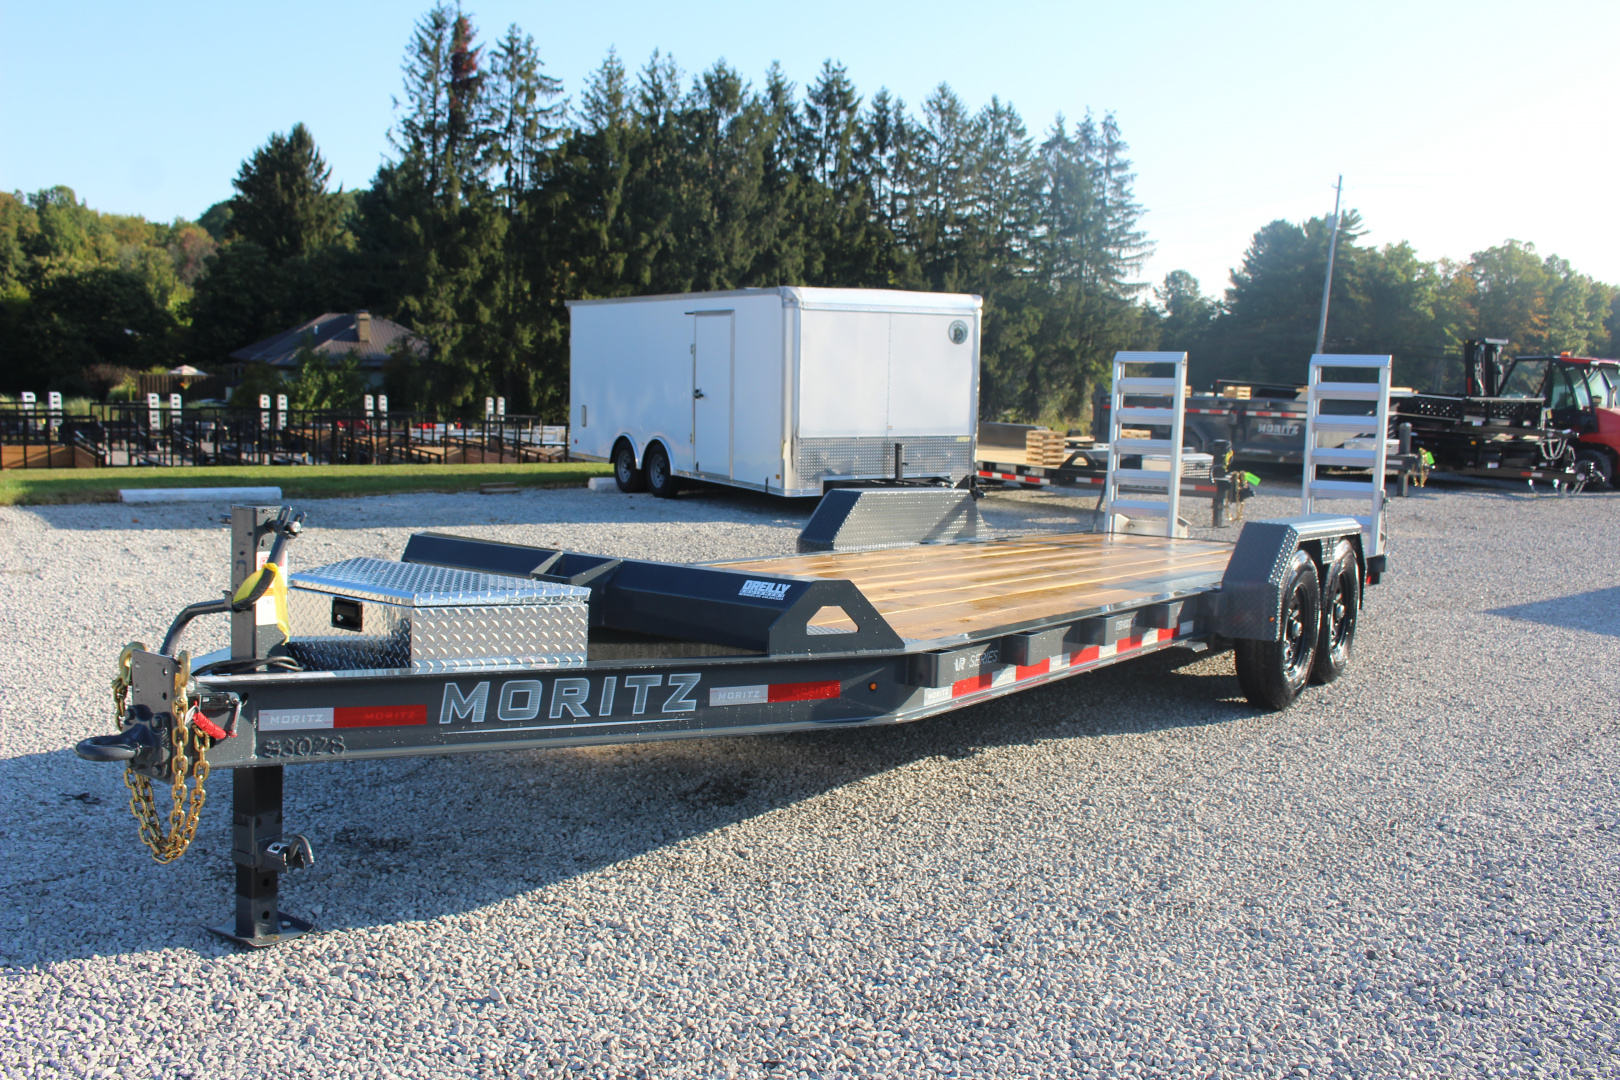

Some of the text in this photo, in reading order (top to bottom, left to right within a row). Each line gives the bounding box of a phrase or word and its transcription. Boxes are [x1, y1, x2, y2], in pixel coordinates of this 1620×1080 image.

[1258, 423, 1299, 434] MORITZ
[969, 650, 998, 667] SERIES
[438, 672, 702, 725] MORITZ
[718, 690, 760, 700] MORITZ
[269, 713, 325, 725] MORITZ
[364, 710, 416, 721] MORITZ
